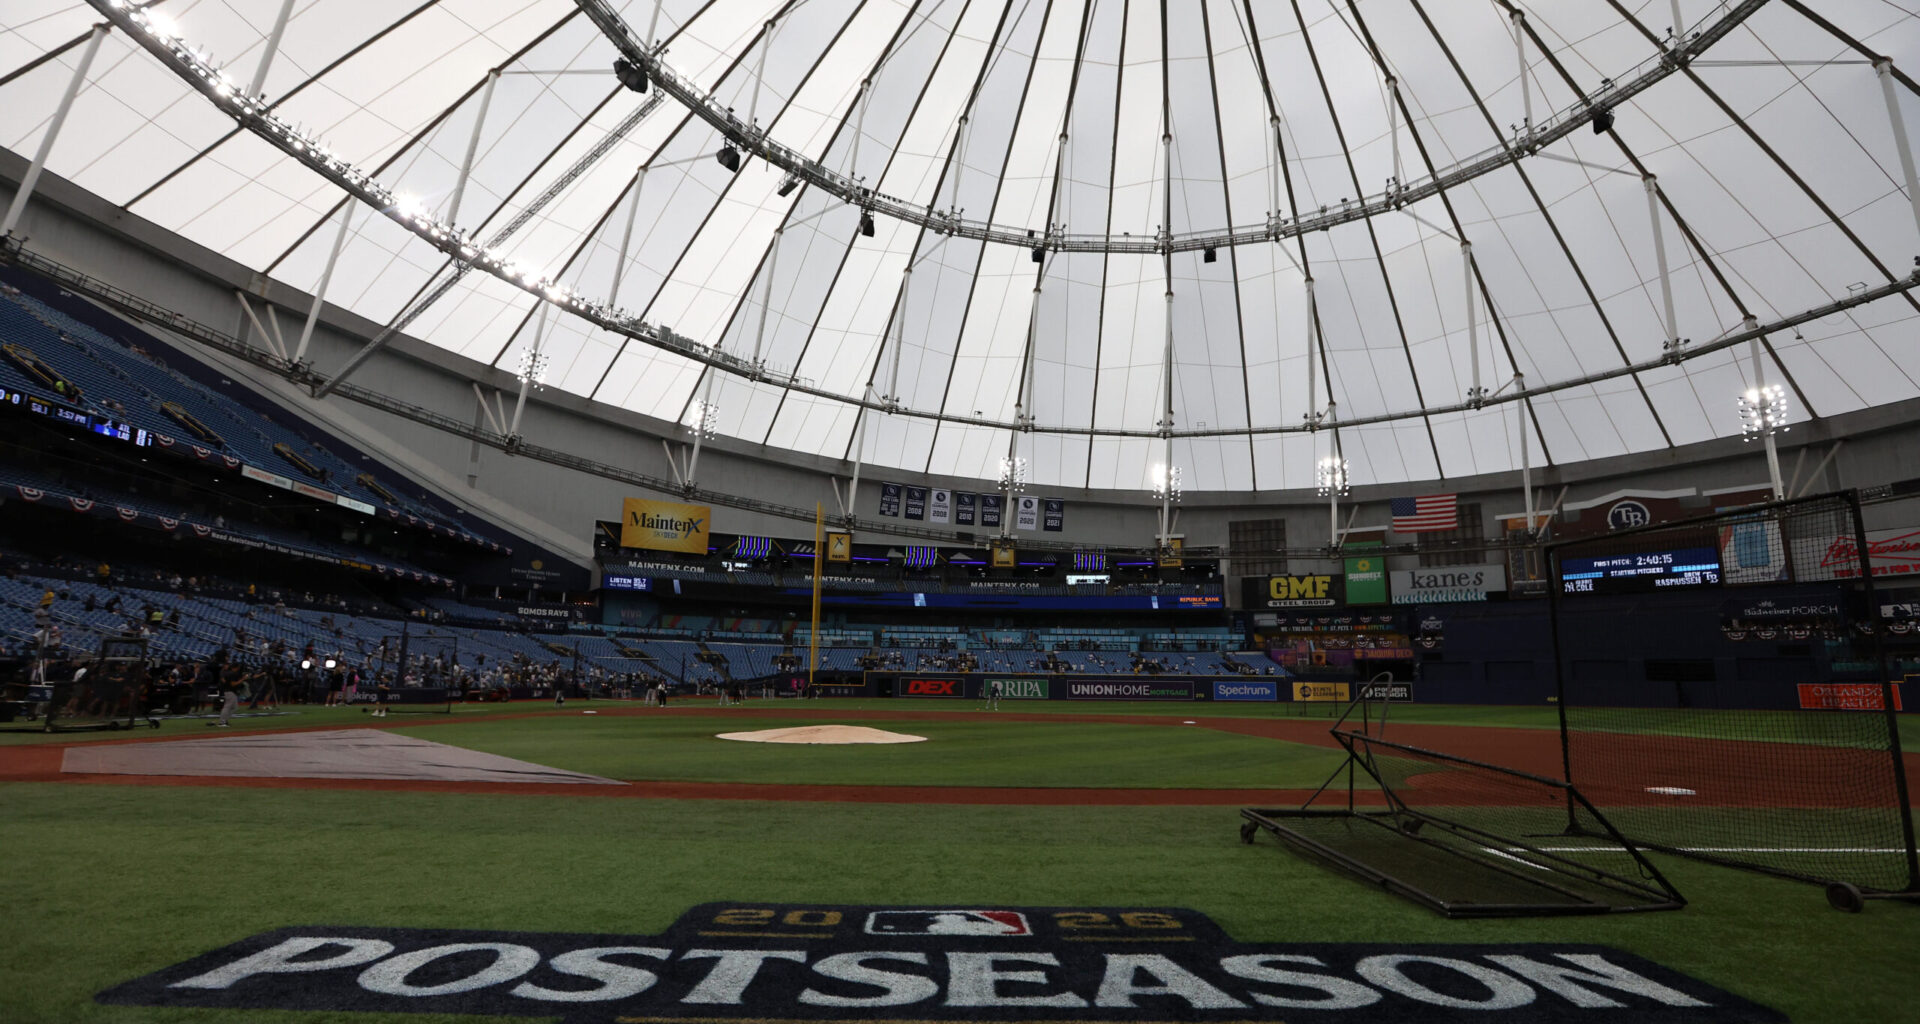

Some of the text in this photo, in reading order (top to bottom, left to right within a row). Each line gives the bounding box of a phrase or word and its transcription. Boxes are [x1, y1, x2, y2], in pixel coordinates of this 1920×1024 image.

[629, 511, 703, 539] MaintenX
[1636, 554, 1673, 566] 2:40:15
[1889, 565, 1910, 574] FOR
[1410, 571, 1484, 589] kanes
[1654, 577, 1702, 587] RASMUSSEN
[1269, 576, 1331, 600] GMF
[1575, 583, 1595, 592] COLE
[517, 606, 569, 618] SOMOS RAYS
[1791, 603, 1839, 615] PORCH
[907, 680, 955, 695] DEX
[1005, 680, 1043, 697] RIPA
[1149, 689, 1189, 697] MORTGAGE
[1218, 684, 1266, 698] Spectrum
[713, 908, 1183, 929] 20 26
[166, 937, 1714, 1010] POSTSEASON
